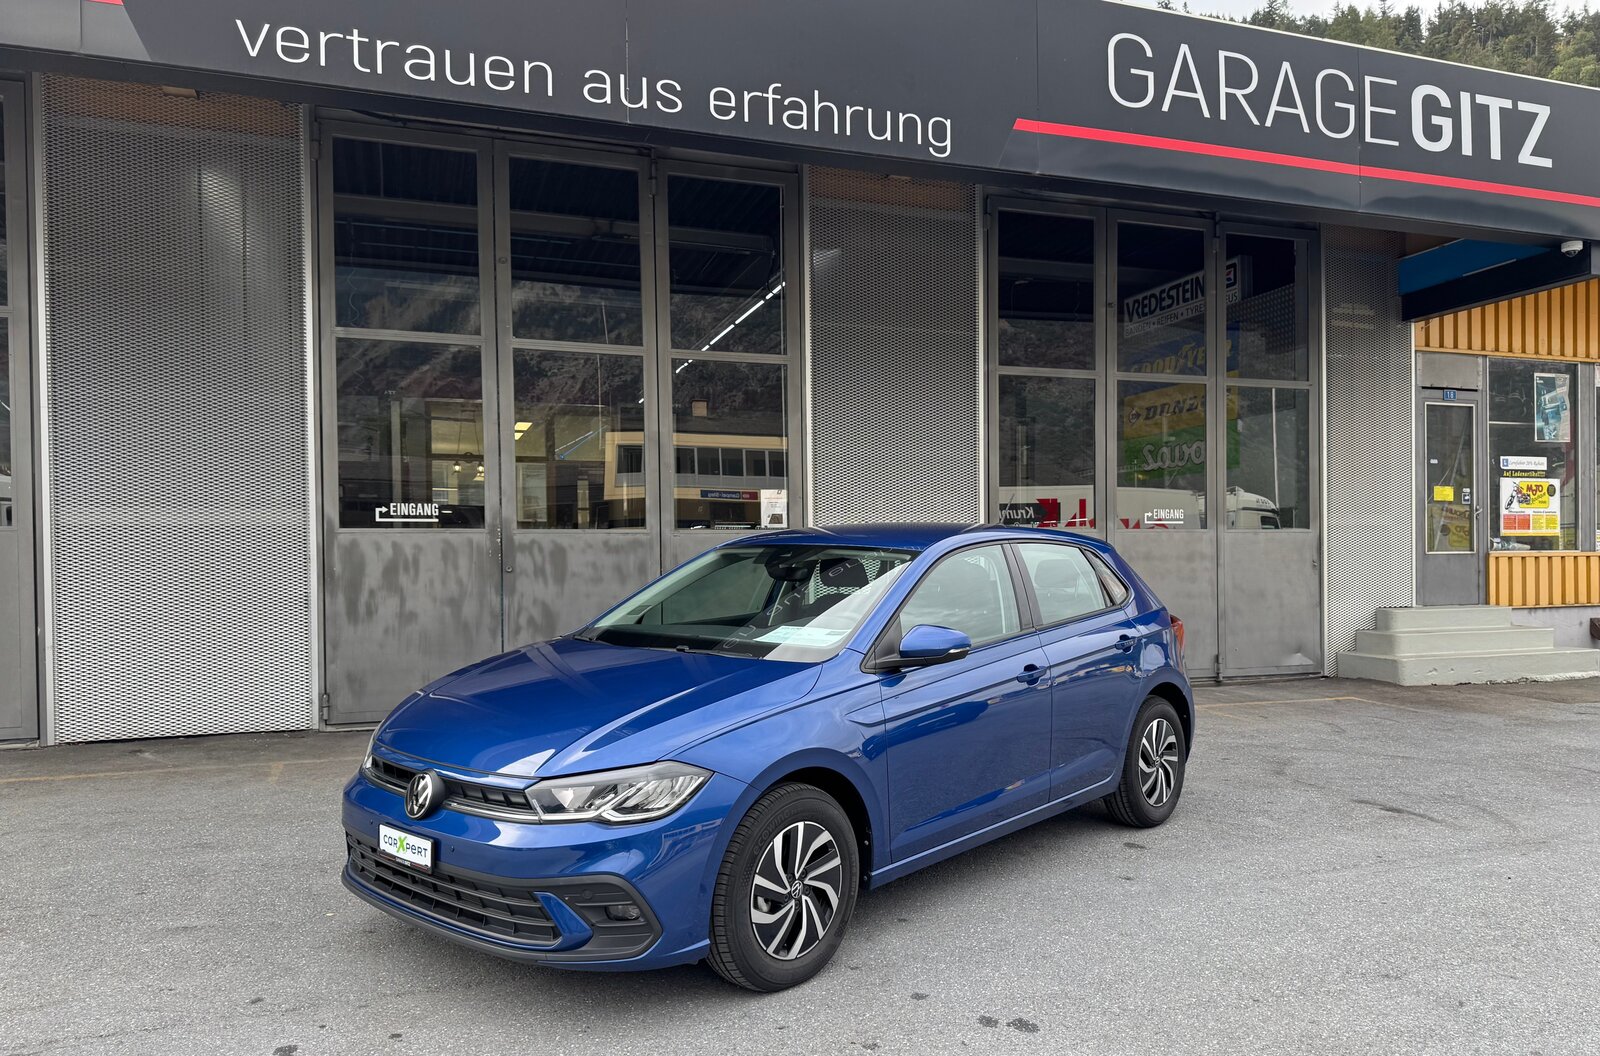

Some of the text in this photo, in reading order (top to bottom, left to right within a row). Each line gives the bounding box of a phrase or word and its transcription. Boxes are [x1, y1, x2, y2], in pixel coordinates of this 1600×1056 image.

[235, 18, 953, 157] vertrauen aus erfahrung
[1107, 32, 1553, 168] GARAGE GITZ
[1126, 275, 1205, 322] VREDESTEIN
[1186, 302, 1206, 317] TYRE
[390, 503, 439, 516] EINGANG
[1153, 508, 1184, 519] EINGANG
